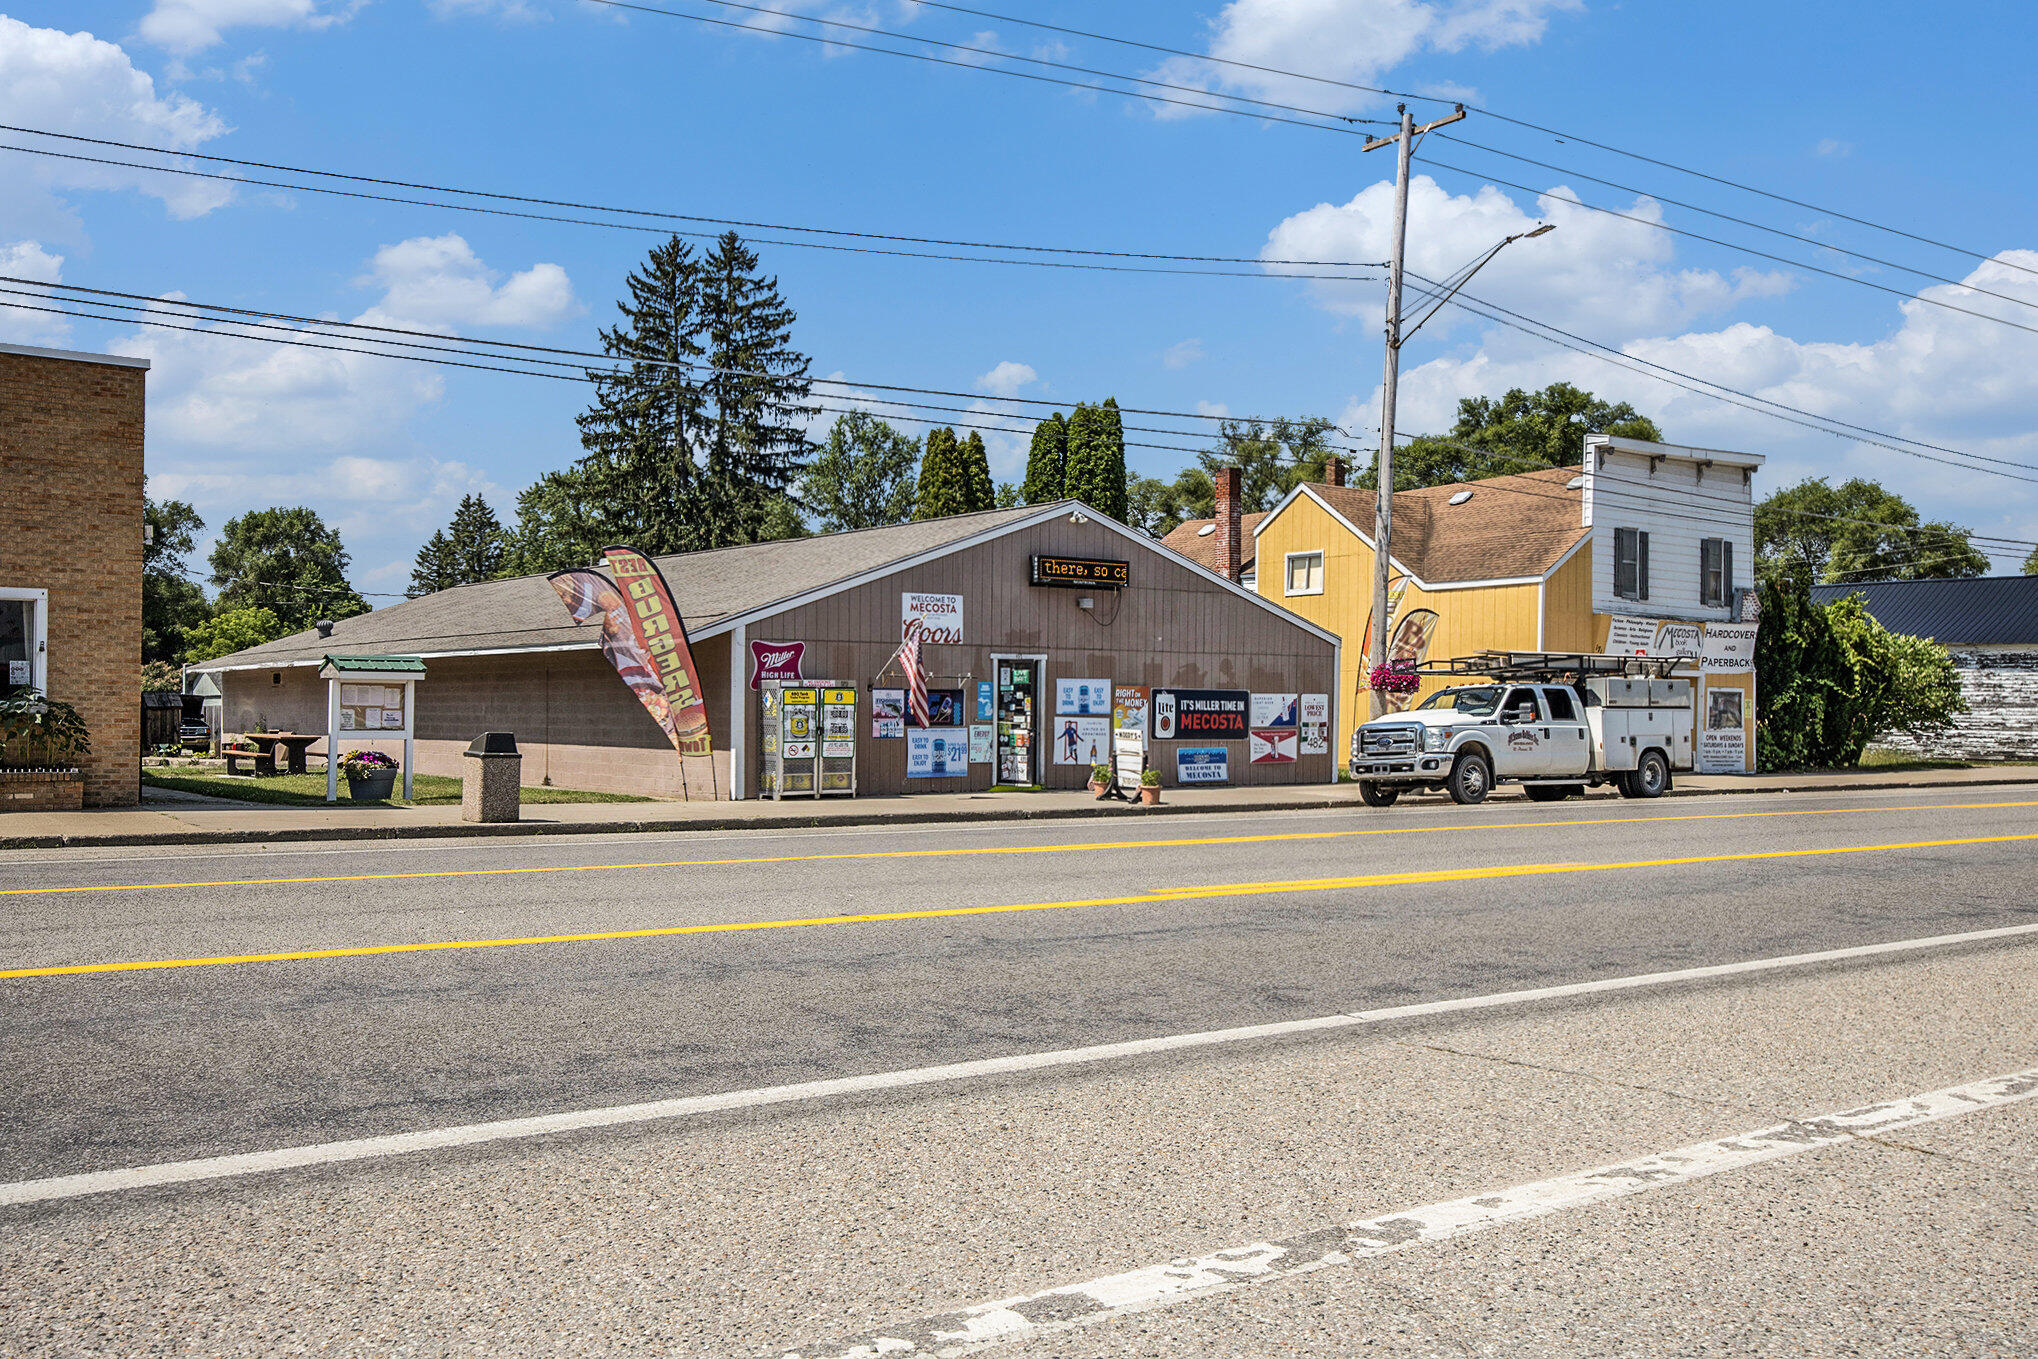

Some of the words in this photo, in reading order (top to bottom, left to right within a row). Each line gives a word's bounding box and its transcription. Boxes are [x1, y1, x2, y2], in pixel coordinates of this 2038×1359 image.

[1045, 560, 1088, 576] there,
[1094, 566, 1108, 577] so
[910, 595, 946, 604] WELCOME
[947, 596, 957, 604] TO
[910, 603, 957, 614] MECOSTA
[903, 618, 962, 644] Coors
[1705, 629, 1755, 639] HARDCOVER
[760, 650, 795, 670] Miller
[761, 671, 779, 679] HIGH
[1115, 688, 1135, 698] RIGHT
[1125, 699, 1147, 708] MONEY
[1158, 702, 1174, 715] Lite
[1181, 700, 1194, 711] IT'S
[1195, 700, 1219, 711] MILLER
[1221, 700, 1237, 711] TIME
[1237, 701, 1245, 711] IN
[1181, 713, 1243, 730] MECOSTA
[1307, 736, 1324, 749] 482
[1186, 771, 1222, 779] MECOSTA
